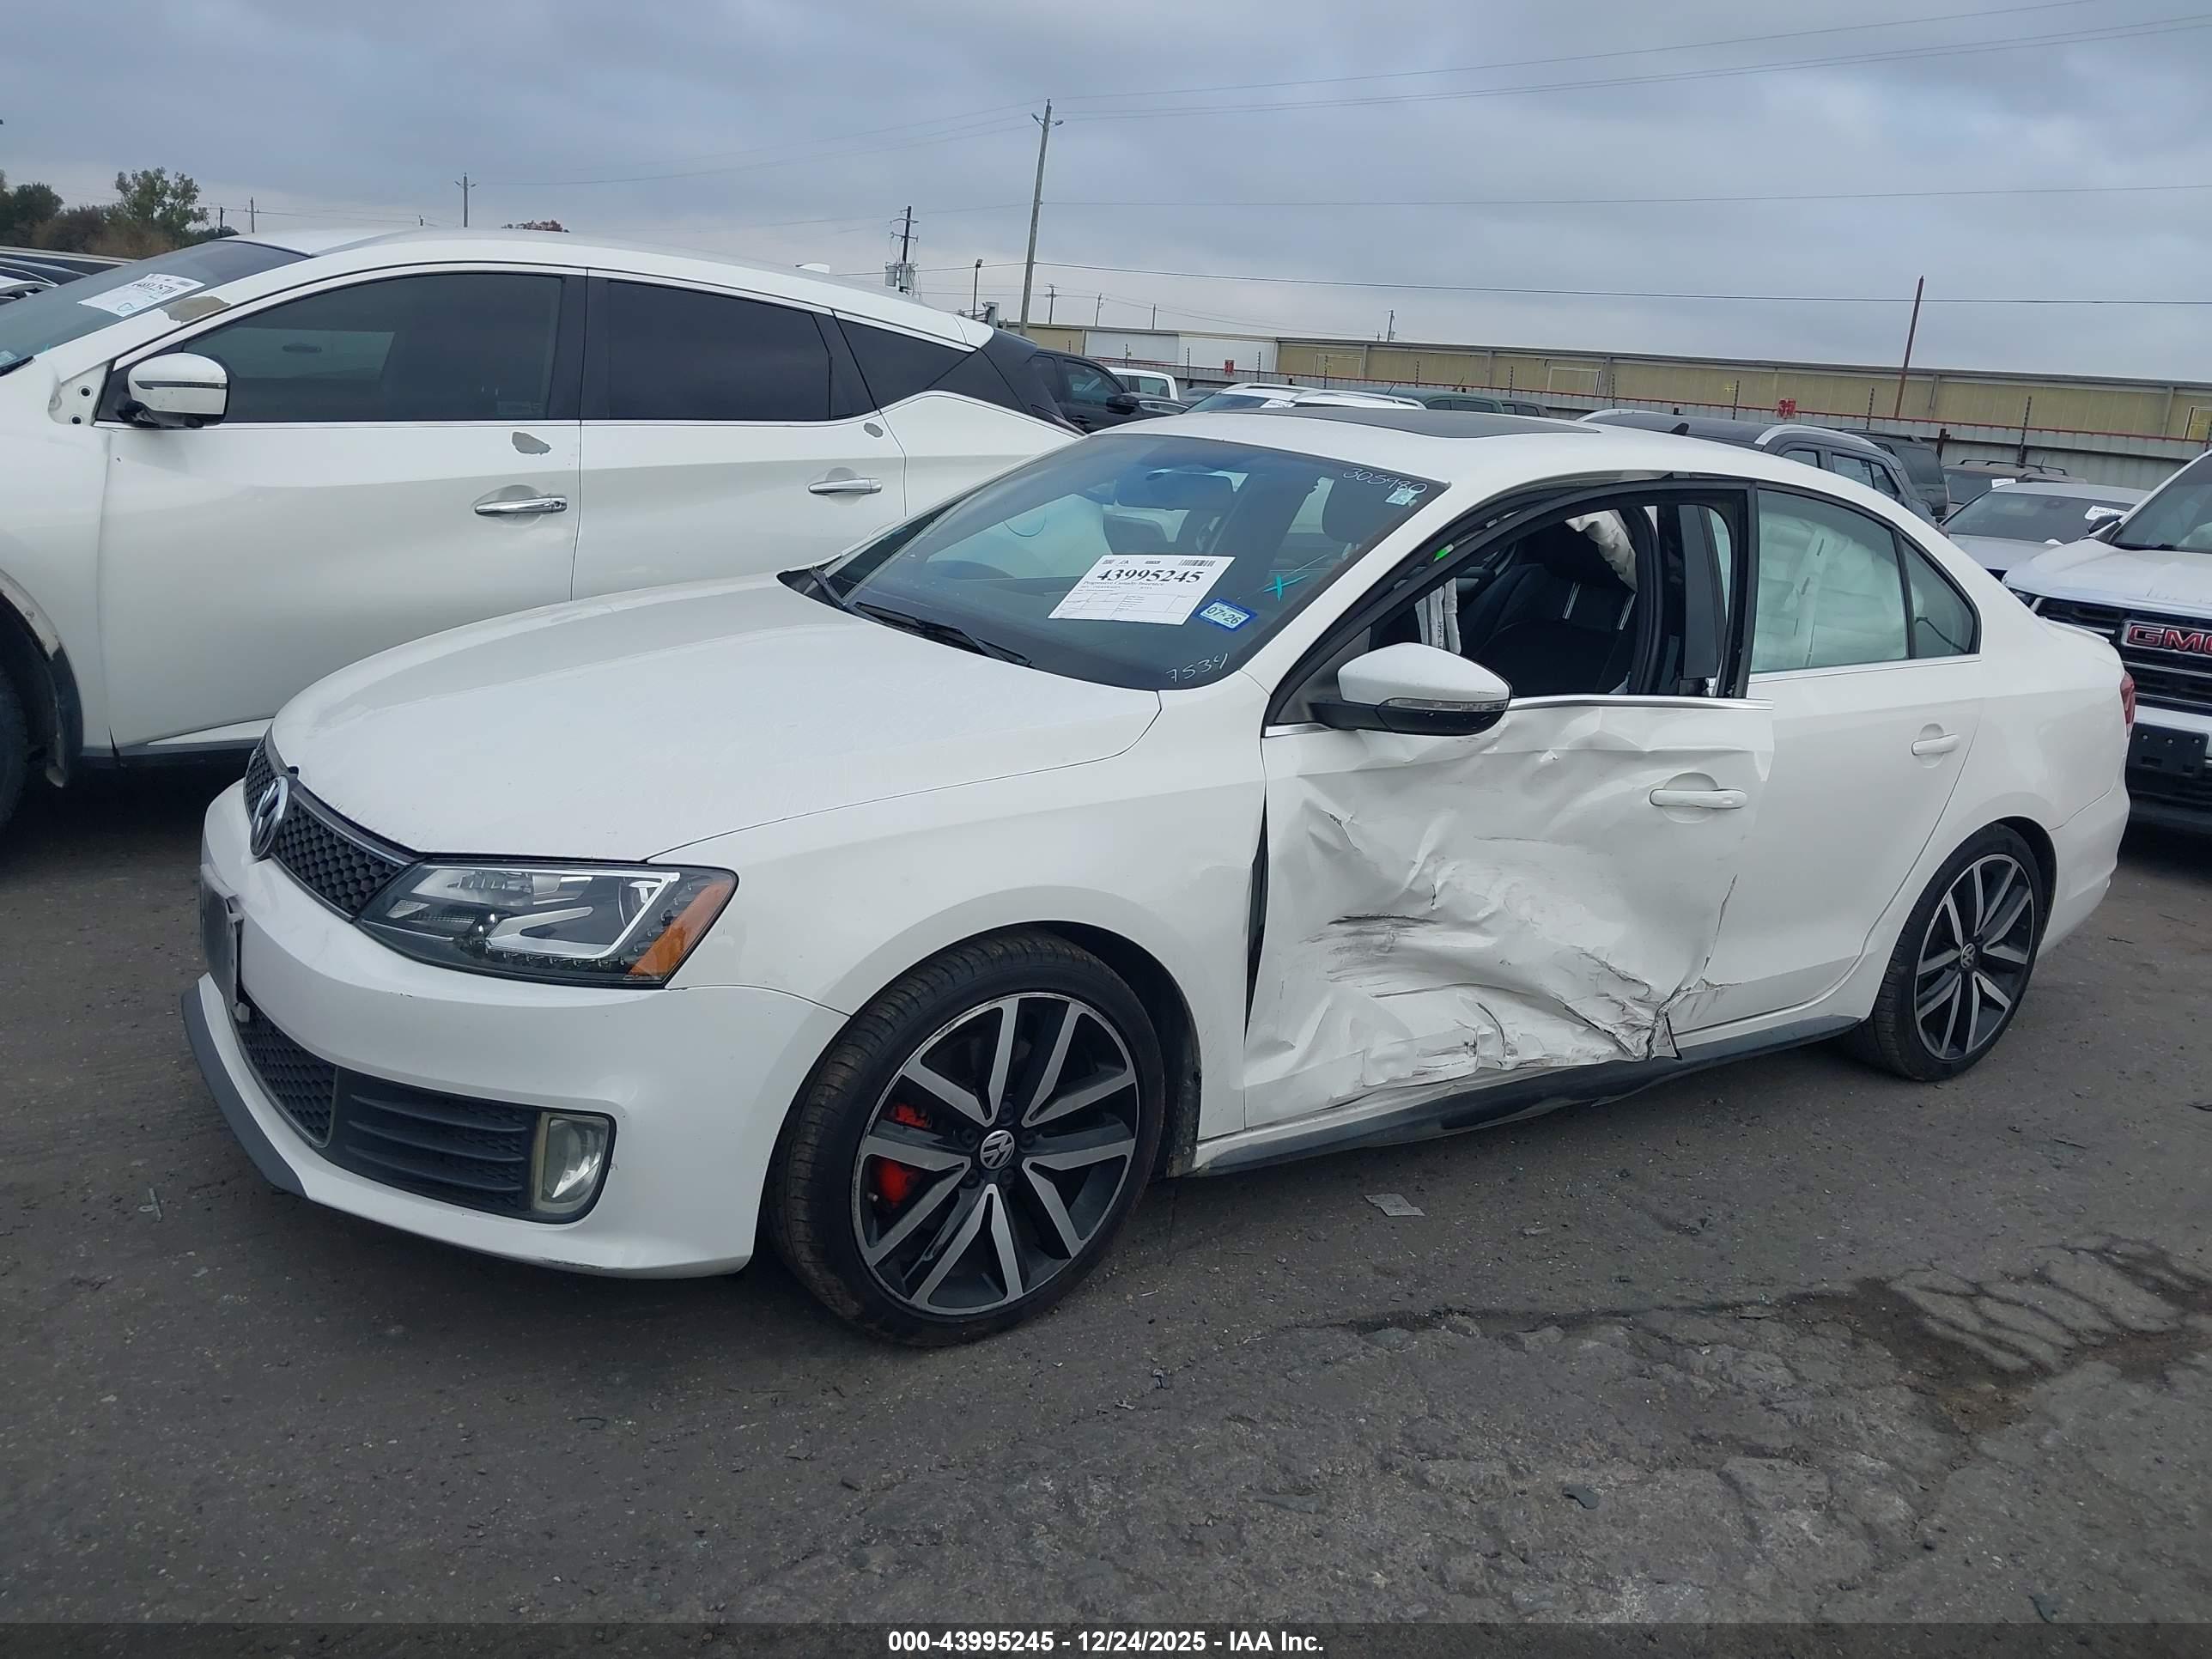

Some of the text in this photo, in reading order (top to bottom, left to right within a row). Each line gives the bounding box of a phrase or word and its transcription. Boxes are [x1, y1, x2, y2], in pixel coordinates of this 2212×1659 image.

[1097, 568, 1205, 583] 43995245
[2129, 624, 2212, 654] GM
[1166, 653, 1228, 683] 7534
